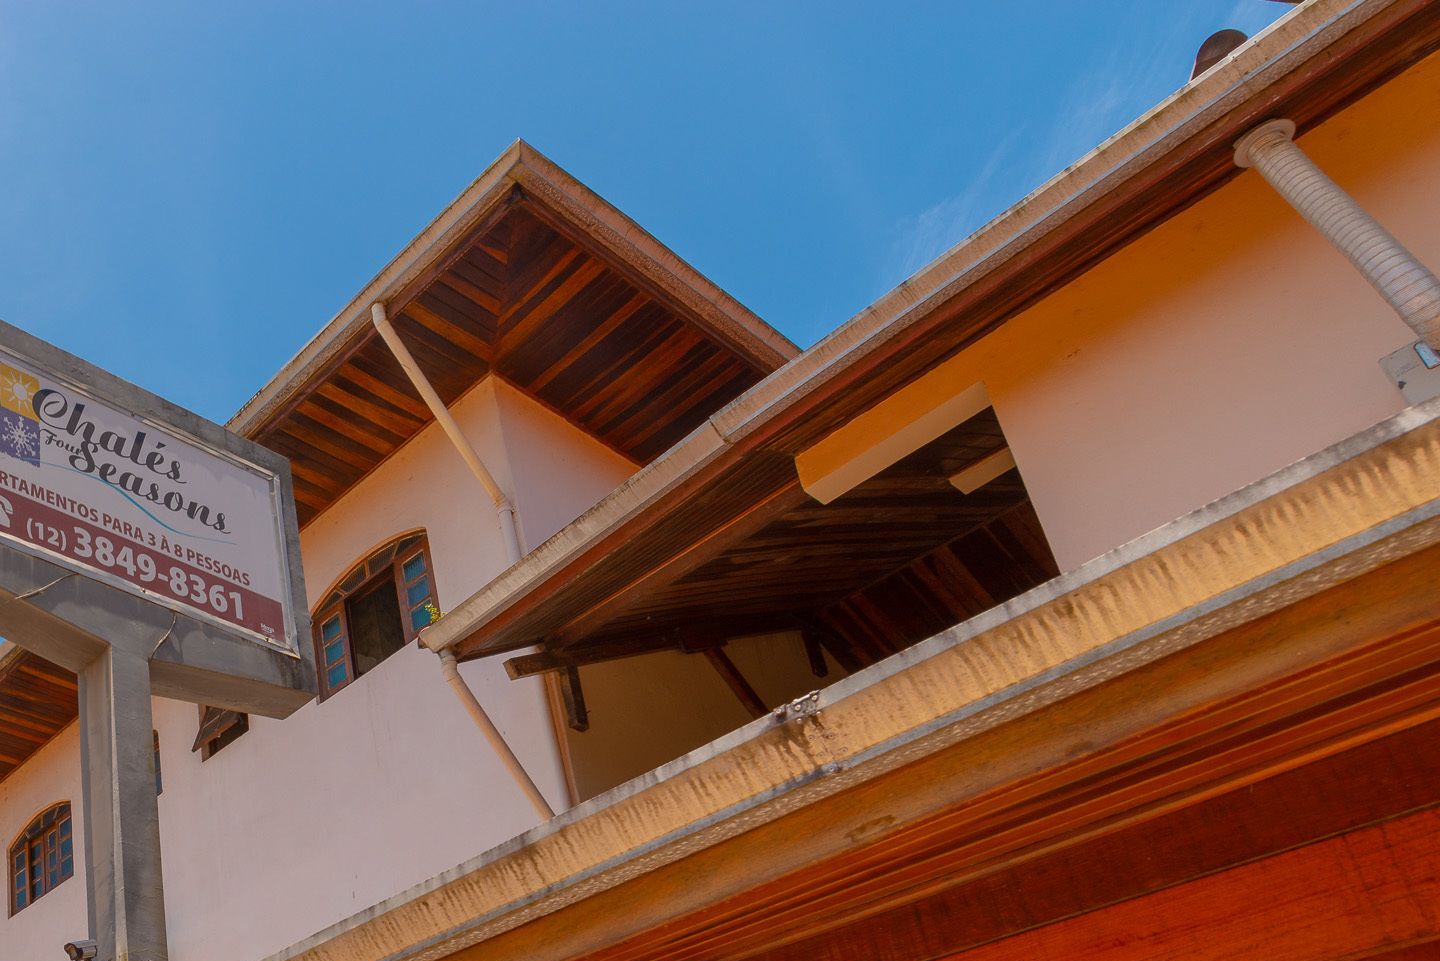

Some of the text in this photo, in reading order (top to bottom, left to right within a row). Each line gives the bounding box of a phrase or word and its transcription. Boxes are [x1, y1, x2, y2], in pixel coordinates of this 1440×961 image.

[32, 389, 188, 484] Chalés
[40, 428, 231, 534] Four Seasons
[26, 517, 244, 621] (12) 3849-8361
[103, 513, 144, 542] PARA
[148, 532, 156, 547] 3
[161, 535, 171, 553] À
[174, 544, 183, 558] 8
[187, 548, 250, 586] PESSOAS
